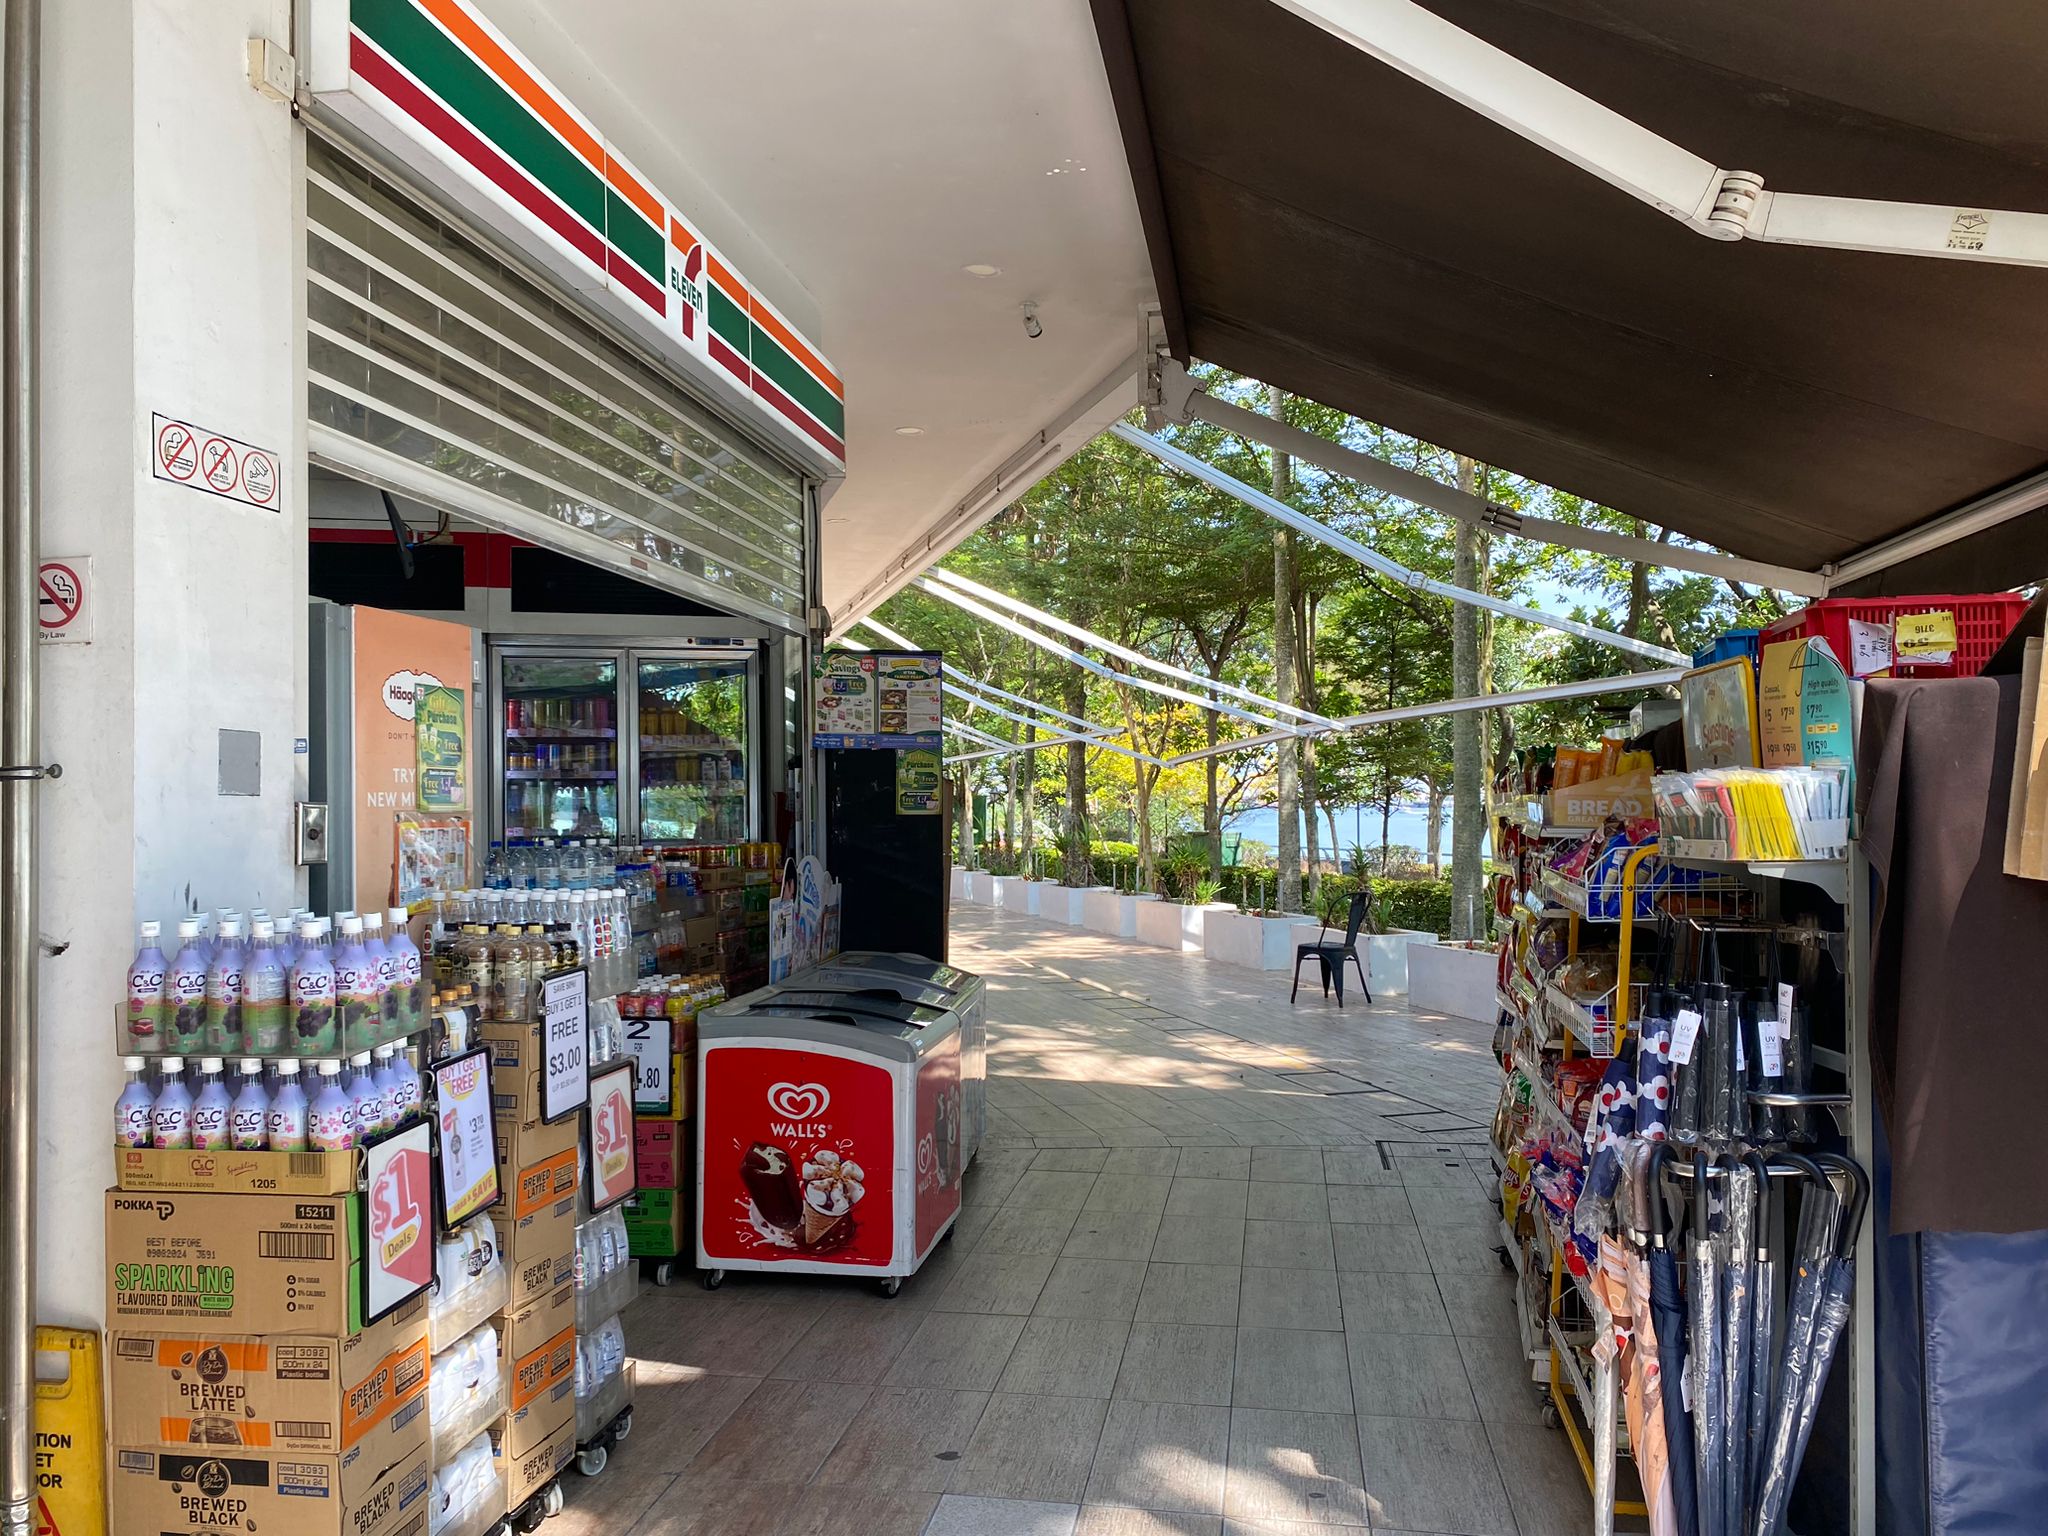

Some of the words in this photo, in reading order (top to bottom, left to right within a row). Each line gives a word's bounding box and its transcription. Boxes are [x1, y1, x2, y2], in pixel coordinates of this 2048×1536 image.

[51, 631, 66, 639] Law
[1808, 681, 1820, 690] High
[388, 731, 409, 741] DON'T
[393, 768, 417, 784] TRY
[367, 792, 397, 808] NEW
[1567, 799, 1643, 817] BREAD
[1568, 815, 1599, 823] GREAT
[132, 973, 163, 988] C&C
[177, 974, 207, 989] C&C
[298, 975, 328, 990] C&C
[553, 983, 565, 994] SAVE
[546, 1005, 559, 1017] BUY
[565, 997, 577, 1010] GET
[551, 1016, 578, 1042] FREE
[627, 1021, 651, 1040] 2
[1680, 1025, 1692, 1033] UV
[550, 1046, 581, 1077] $3.00
[439, 1067, 455, 1083] BUY
[451, 1072, 475, 1095] FREE
[155, 1111, 182, 1126] C&C
[195, 1110, 222, 1125] C&C
[234, 1112, 262, 1127] C&C
[597, 1093, 627, 1153] $1
[771, 1123, 827, 1138] WALL'S
[191, 1159, 214, 1171] C&C
[250, 1179, 277, 1189] 1205
[523, 1168, 551, 1191] BREWED
[373, 1151, 416, 1234] $1
[472, 1175, 493, 1201] SAVE
[527, 1182, 547, 1200] LATTE
[114, 1200, 154, 1211] POKKA
[299, 1206, 331, 1217] 15211
[280, 1222, 299, 1230] 500ml
[146, 1237, 166, 1247] BEST
[171, 1238, 202, 1248] BEFORE
[387, 1232, 412, 1258] Deals
[523, 1257, 552, 1282] BREWED
[527, 1269, 549, 1292] BLACK
[117, 1293, 168, 1307] FLAVOURED
[171, 1294, 201, 1308] DRINK
[282, 1360, 305, 1368] 500ml
[313, 1360, 323, 1369] 24
[519, 1353, 549, 1381] BREWED
[350, 1368, 388, 1408] BREWED
[524, 1370, 545, 1391] LATTE
[180, 1383, 246, 1399] BREWED
[191, 1397, 236, 1412] LATTE
[357, 1386, 384, 1416] LATTE
[36, 1432, 72, 1449] TION
[523, 1444, 554, 1477] BREWED
[300, 1465, 324, 1475] 3093
[527, 1460, 551, 1485] BLACK
[283, 1476, 304, 1485] 500ml
[314, 1478, 323, 1486] 24
[283, 1486, 304, 1495] Plastic
[305, 1487, 324, 1496] bottle
[180, 1496, 247, 1512] BREWED
[354, 1481, 395, 1525] BREWED
[189, 1511, 239, 1526] BLACK
[360, 1503, 391, 1535] BLACK
